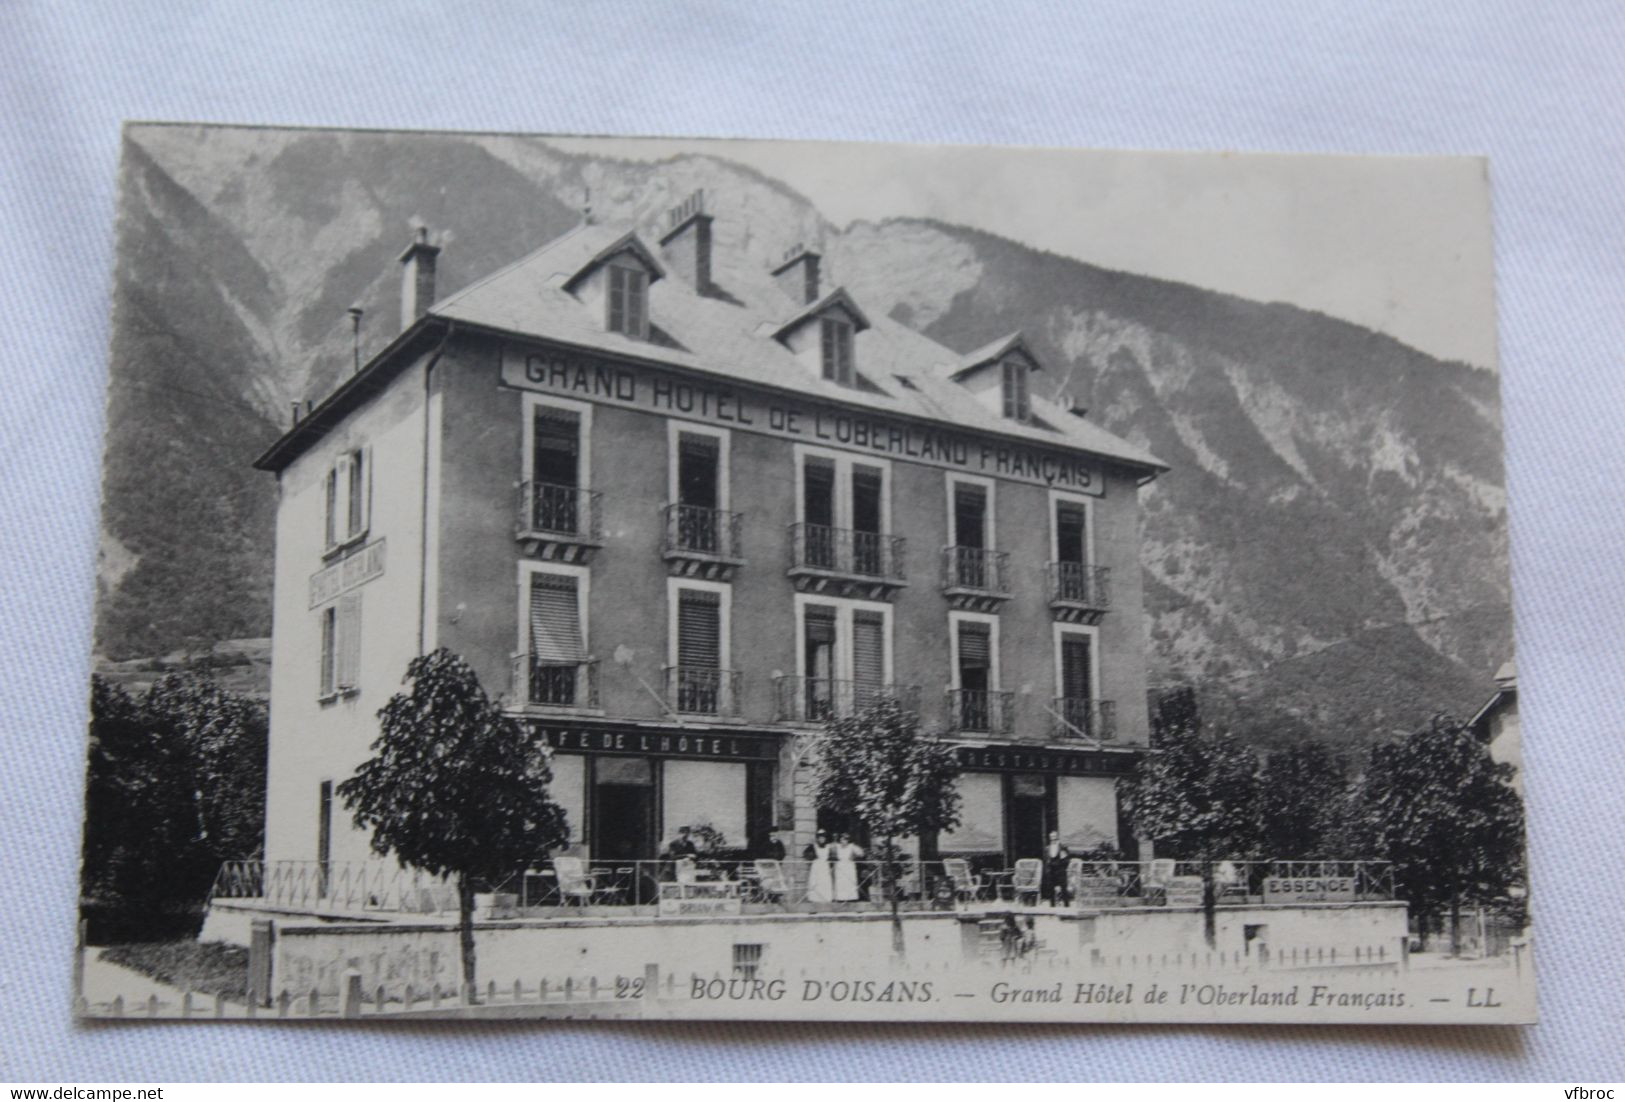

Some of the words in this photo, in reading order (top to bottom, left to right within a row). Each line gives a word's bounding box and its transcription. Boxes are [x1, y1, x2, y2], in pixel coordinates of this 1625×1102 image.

[525, 353, 635, 402] GRAND
[653, 377, 754, 425] HOTEL
[770, 405, 800, 434] DE
[980, 447, 1092, 488] FRANÇAIS
[603, 733, 625, 749] DE
[1269, 880, 1350, 894] ESSENCE
[614, 977, 646, 999] 22
[690, 978, 787, 1000] BOURG
[991, 982, 1063, 1004] Grand
[1073, 983, 1133, 1004] Hôtel
[1144, 984, 1168, 1004] de
[1180, 984, 1299, 1005] l'Oberland
[1466, 987, 1502, 1007] LL
